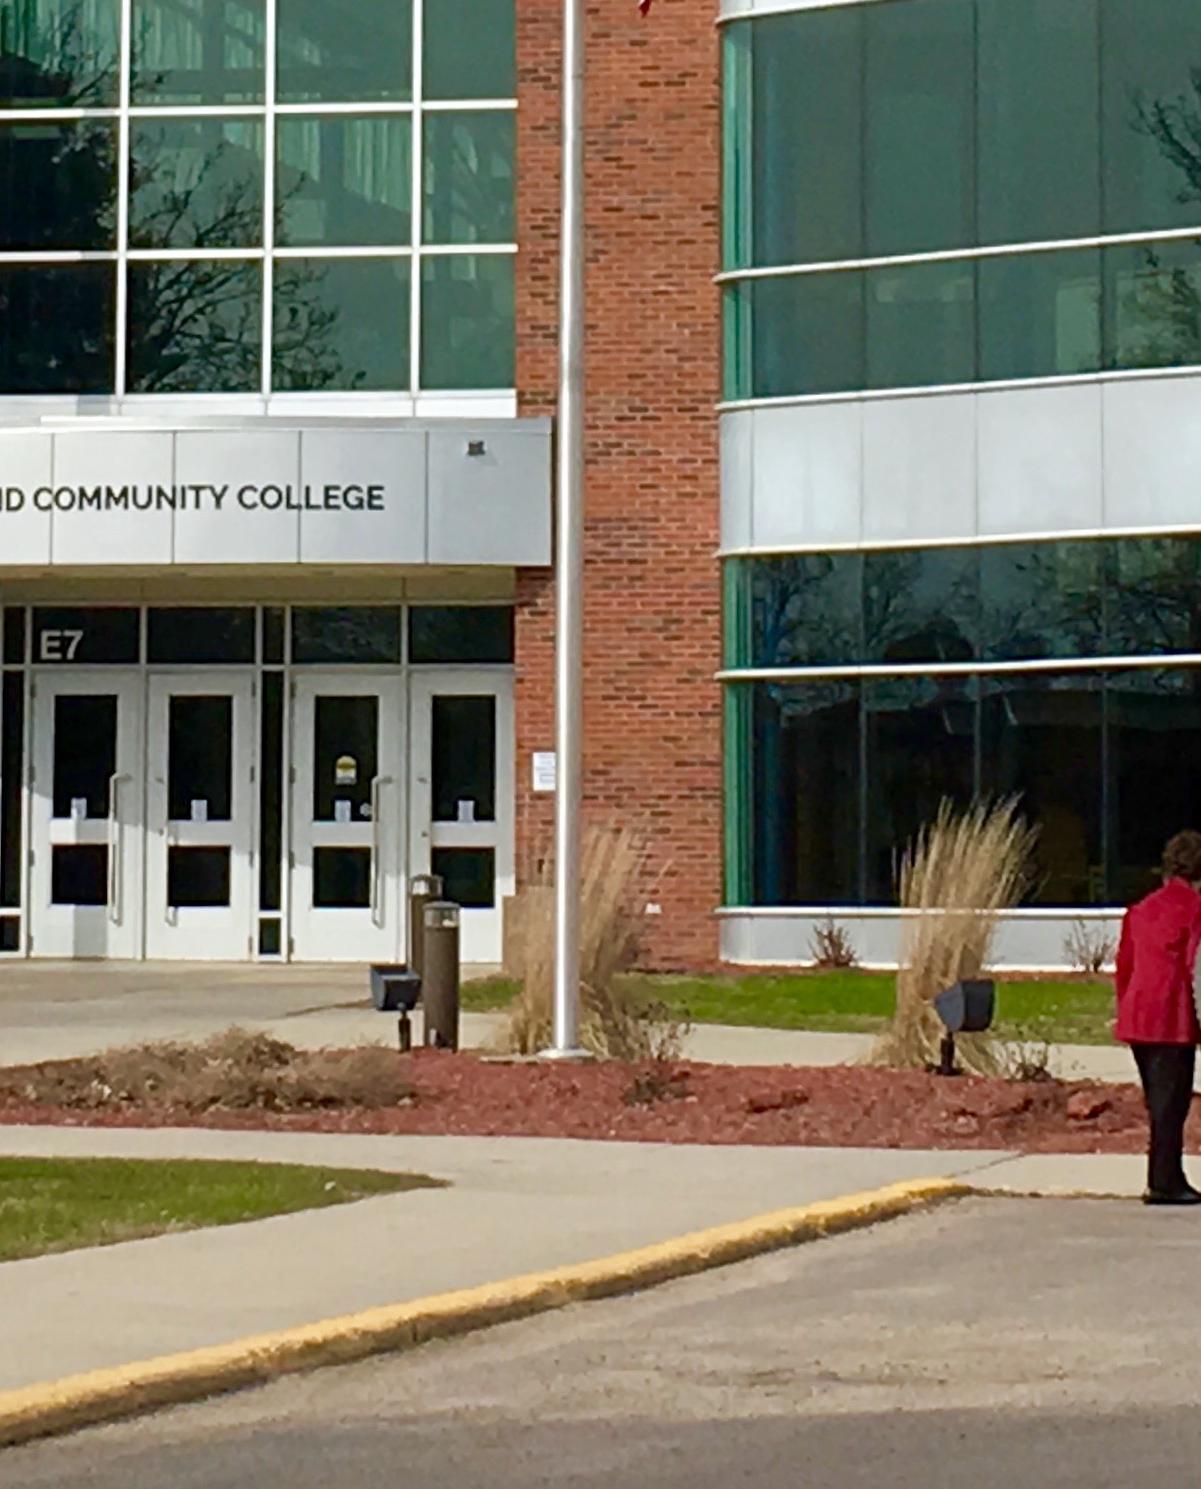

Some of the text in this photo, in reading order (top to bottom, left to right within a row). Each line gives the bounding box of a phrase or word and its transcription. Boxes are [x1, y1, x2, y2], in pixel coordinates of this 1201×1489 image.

[33, 485, 229, 512] COMMUNITY
[237, 484, 385, 511] COLLEGE
[40, 629, 84, 660] E7
